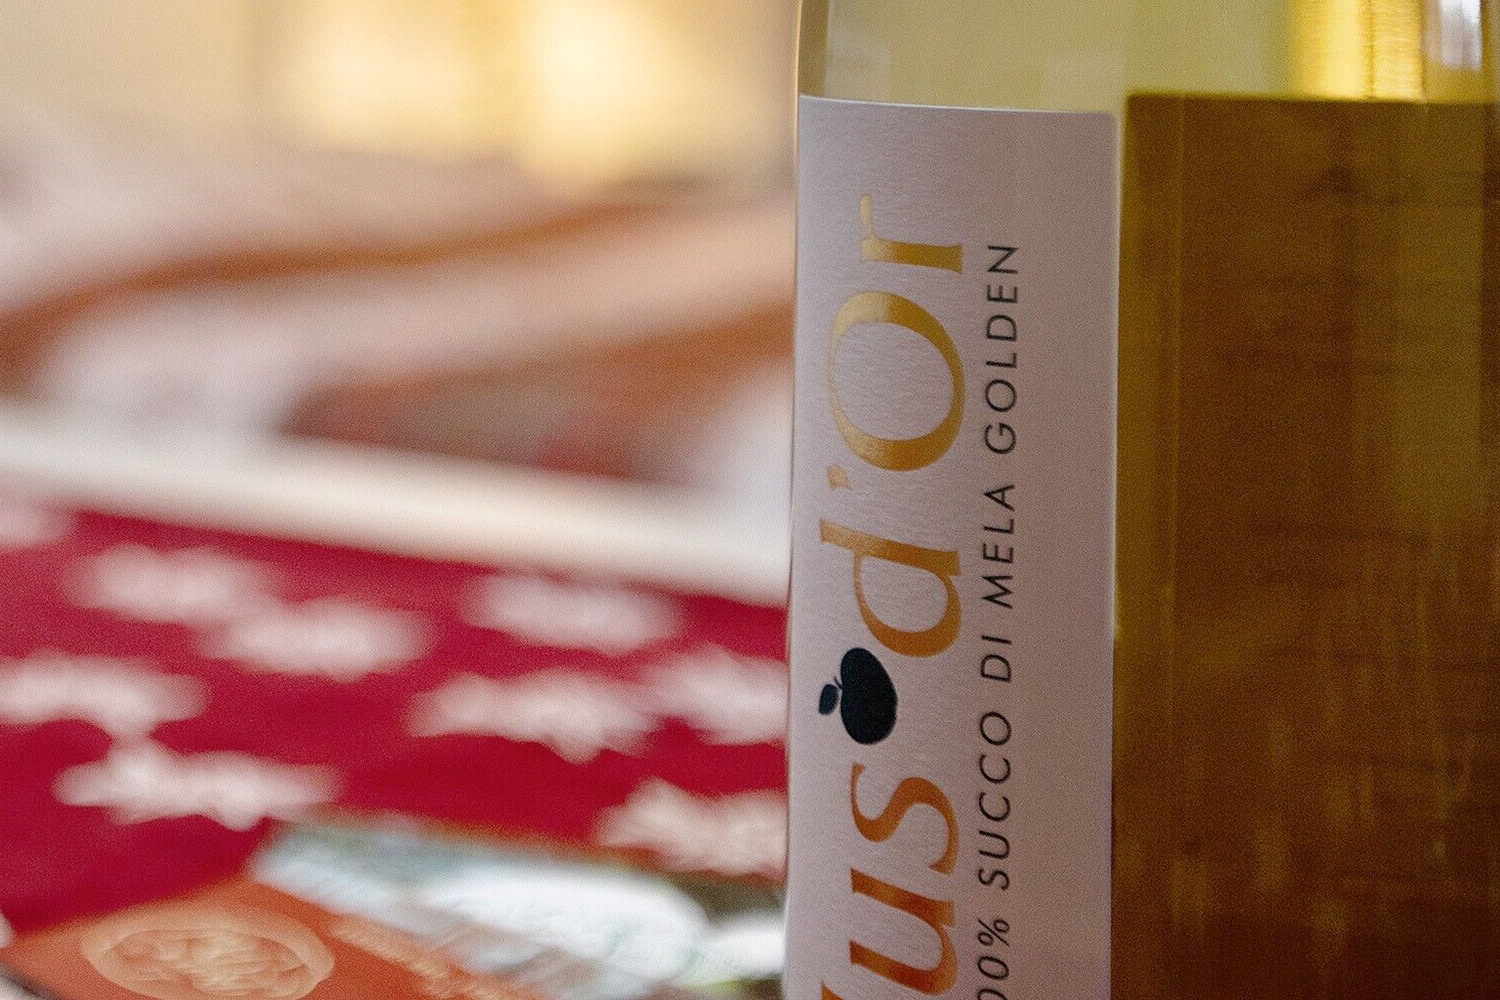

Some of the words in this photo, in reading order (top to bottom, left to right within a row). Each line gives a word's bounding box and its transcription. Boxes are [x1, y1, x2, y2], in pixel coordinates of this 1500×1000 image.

[819, 193, 965, 658] d'Or
[984, 245, 1019, 454] GOLDEN
[981, 484, 1016, 610] MELA
[980, 634, 1013, 683] DI
[820, 762, 959, 1000] us
[977, 711, 1012, 890] SUCCO
